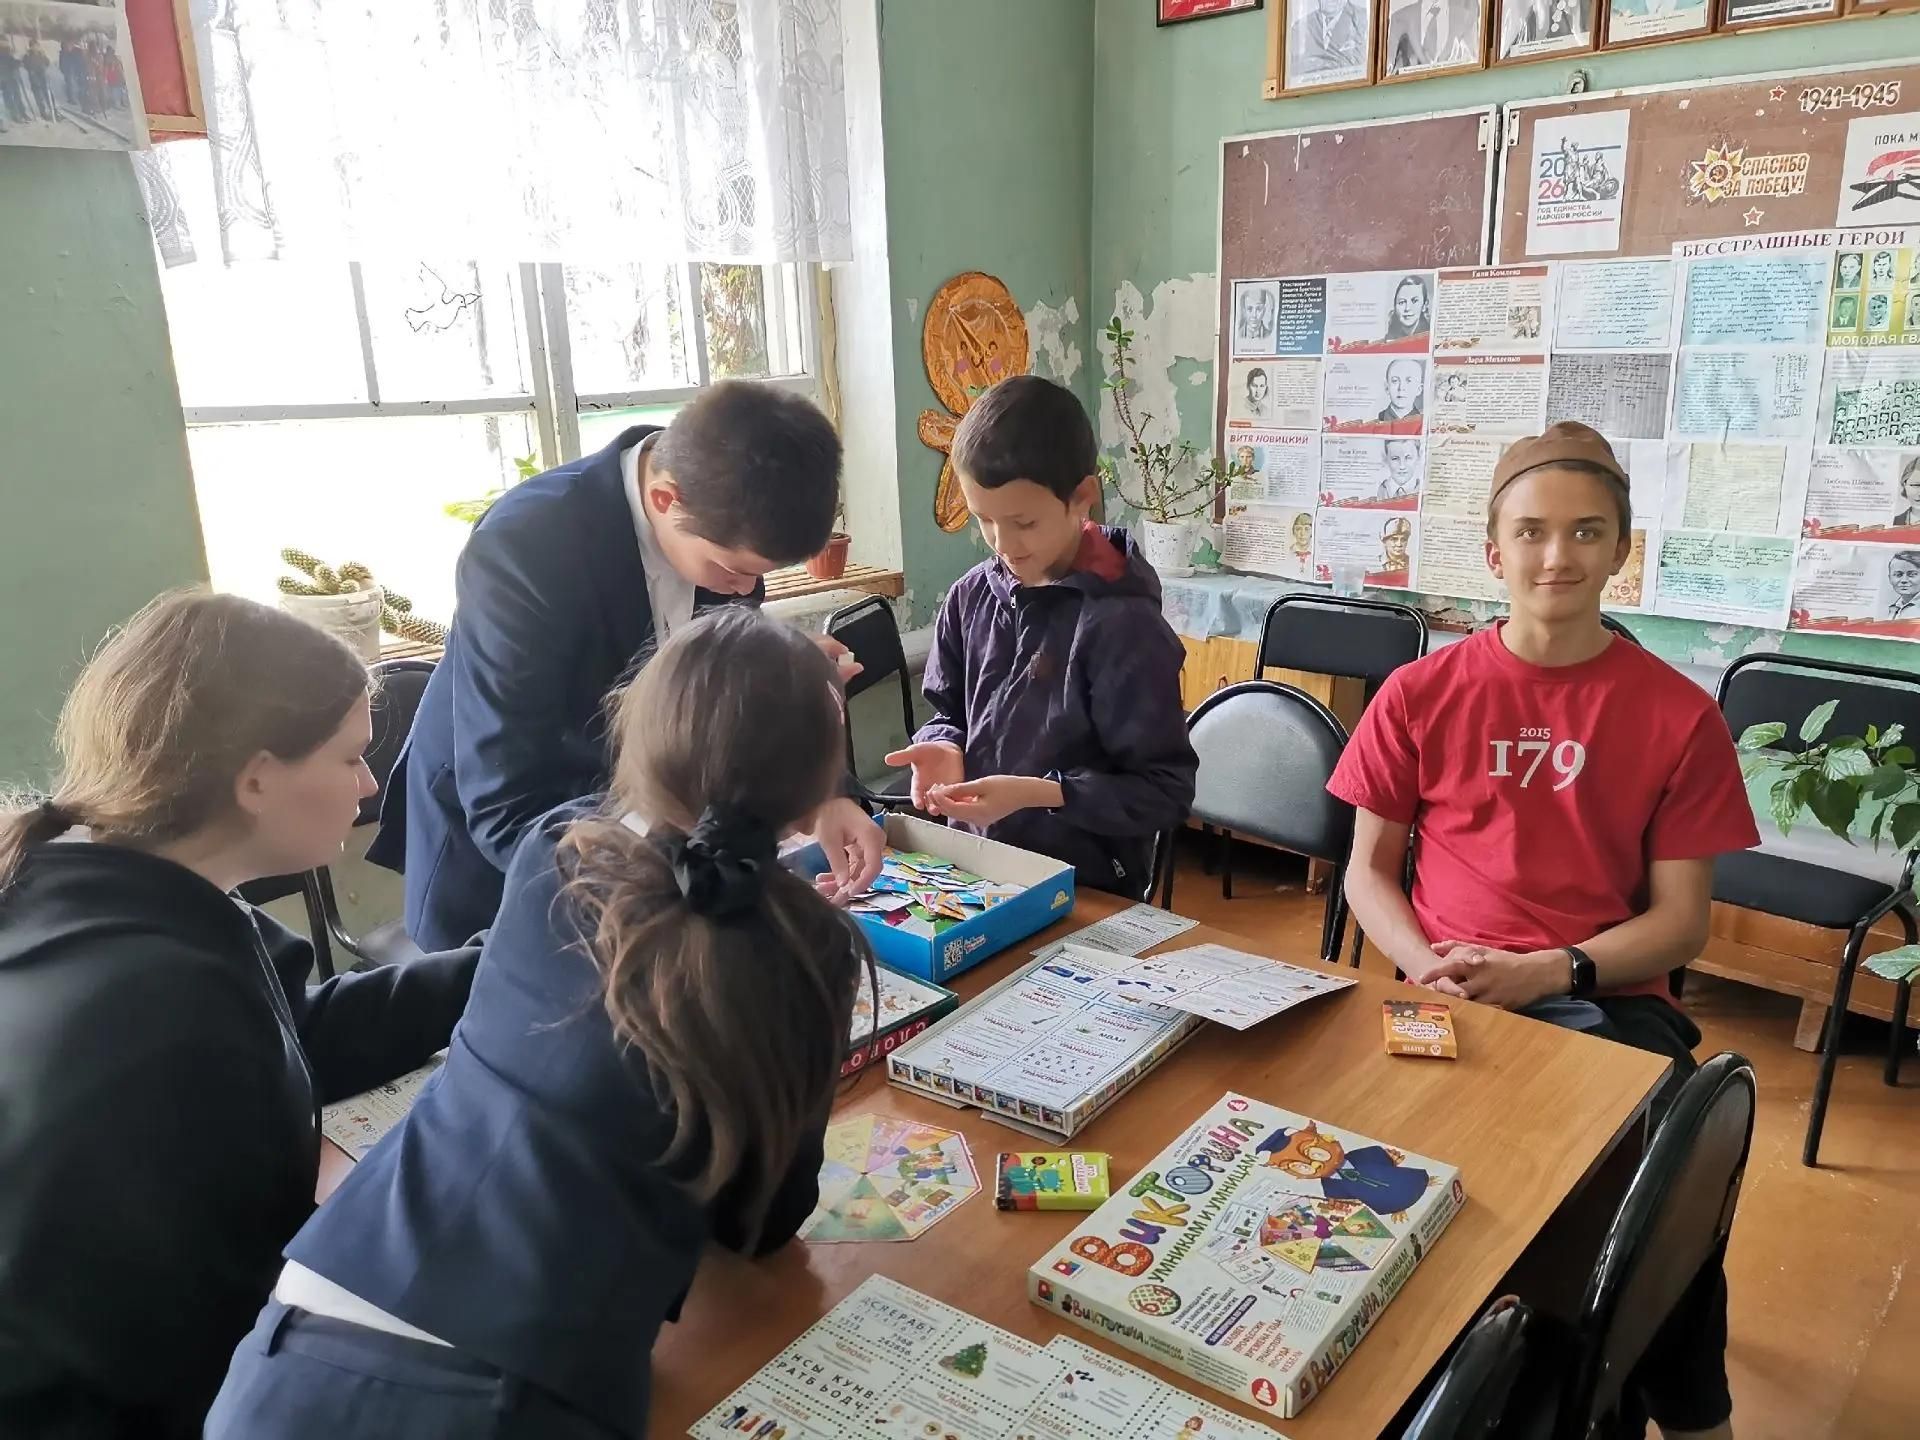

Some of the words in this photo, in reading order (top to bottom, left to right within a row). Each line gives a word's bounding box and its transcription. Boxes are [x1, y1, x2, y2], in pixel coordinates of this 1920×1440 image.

[1800, 83, 1899, 111] 1941-1945
[1874, 133, 1904, 146] ПОКА
[1909, 132, 1920, 143] М
[1539, 157, 1566, 178] 20
[1741, 156, 1807, 176] СПАСИБО
[1537, 179, 1565, 200] 26
[1725, 183, 1741, 197] ЗА
[1745, 175, 1804, 196] ПОБЕДУ!
[1536, 213, 1570, 222] НАРОДОВ
[1571, 209, 1603, 219] РОССИИ
[1537, 206, 1551, 214] ГОД
[1553, 204, 1592, 213] ЕДИНСТВА
[1682, 233, 1832, 258] БЕССТРАШНЫЕ
[1837, 231, 1906, 246] ГЕРОИ
[1831, 334, 1898, 347] МОЛОДАЯ
[1230, 434, 1253, 443] ВИТЯ
[1255, 434, 1309, 445] НОВИЦКИЙ
[1519, 727, 1552, 740] 2015
[1488, 739, 1586, 791] 179
[1147, 1218, 1208, 1283] УМНИКАМ
[1206, 1152, 1260, 1212] УМНИЦАМ
[991, 1335, 1034, 1358] ЧЕЛОВЕК
[1223, 1325, 1248, 1347] ЧЕЛОВЕК
[1233, 1321, 1265, 1354] ПРОФЕССИИ
[1244, 1331, 1272, 1359] ВРЕМЕНА
[1268, 1319, 1284, 1337] ГОДА
[835, 1341, 874, 1365] ЧЕЛОВЕК
[1256, 1332, 1287, 1364] ТРАНСПОРТ
[1268, 1346, 1291, 1369] ПОСУДА
[1081, 1354, 1126, 1379] ЧЕЛОВЕК
[772, 1396, 812, 1422] ЧЕЛОВЕК
[936, 1391, 979, 1416] ЧЕЛОВЕК
[1196, 1408, 1246, 1436] ЧЕЛОВЕК
